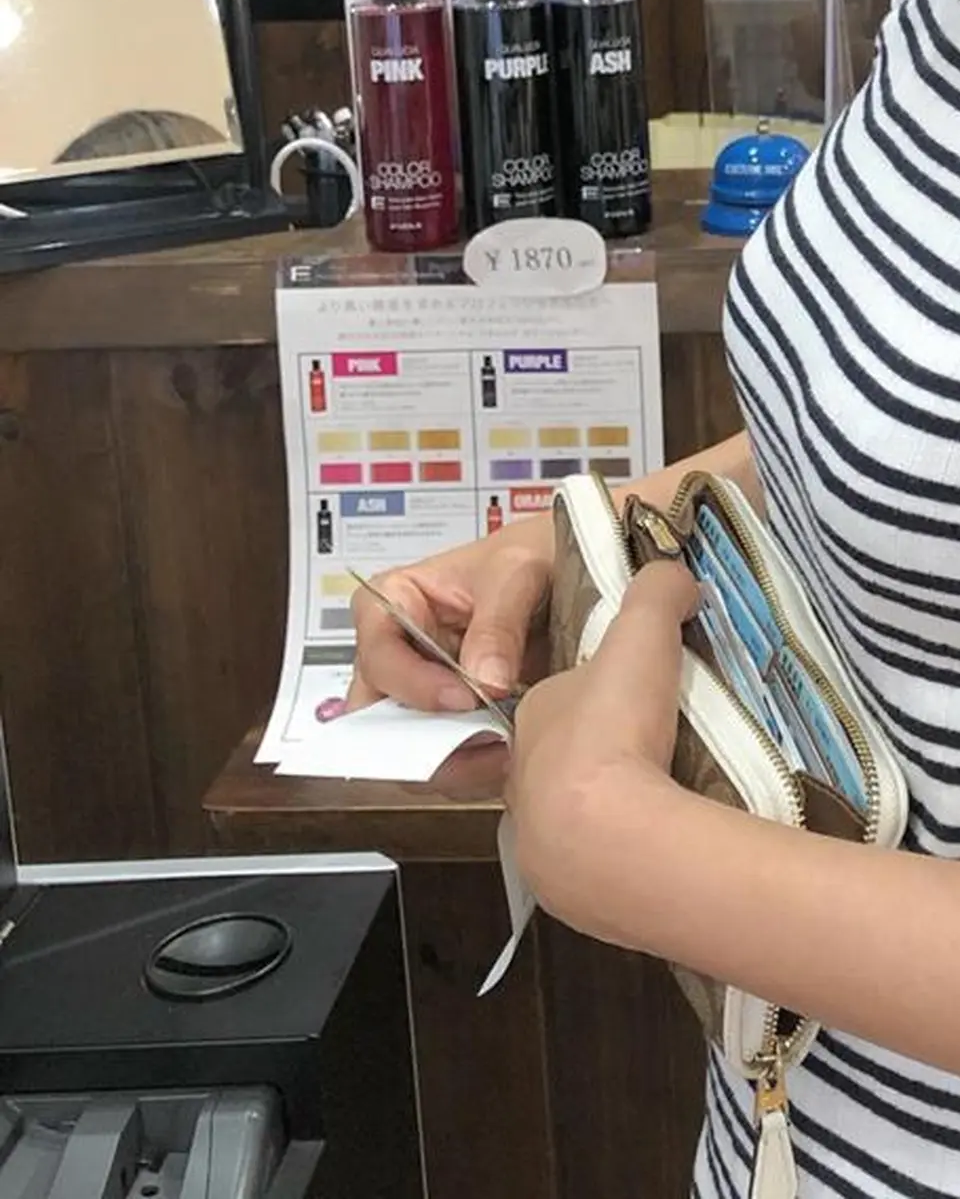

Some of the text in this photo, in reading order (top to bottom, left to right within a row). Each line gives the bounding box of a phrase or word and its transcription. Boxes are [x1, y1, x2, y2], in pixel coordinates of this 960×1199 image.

[370, 58, 424, 82] PINK
[589, 50, 632, 75] ASH
[511, 246, 573, 271] 1870
